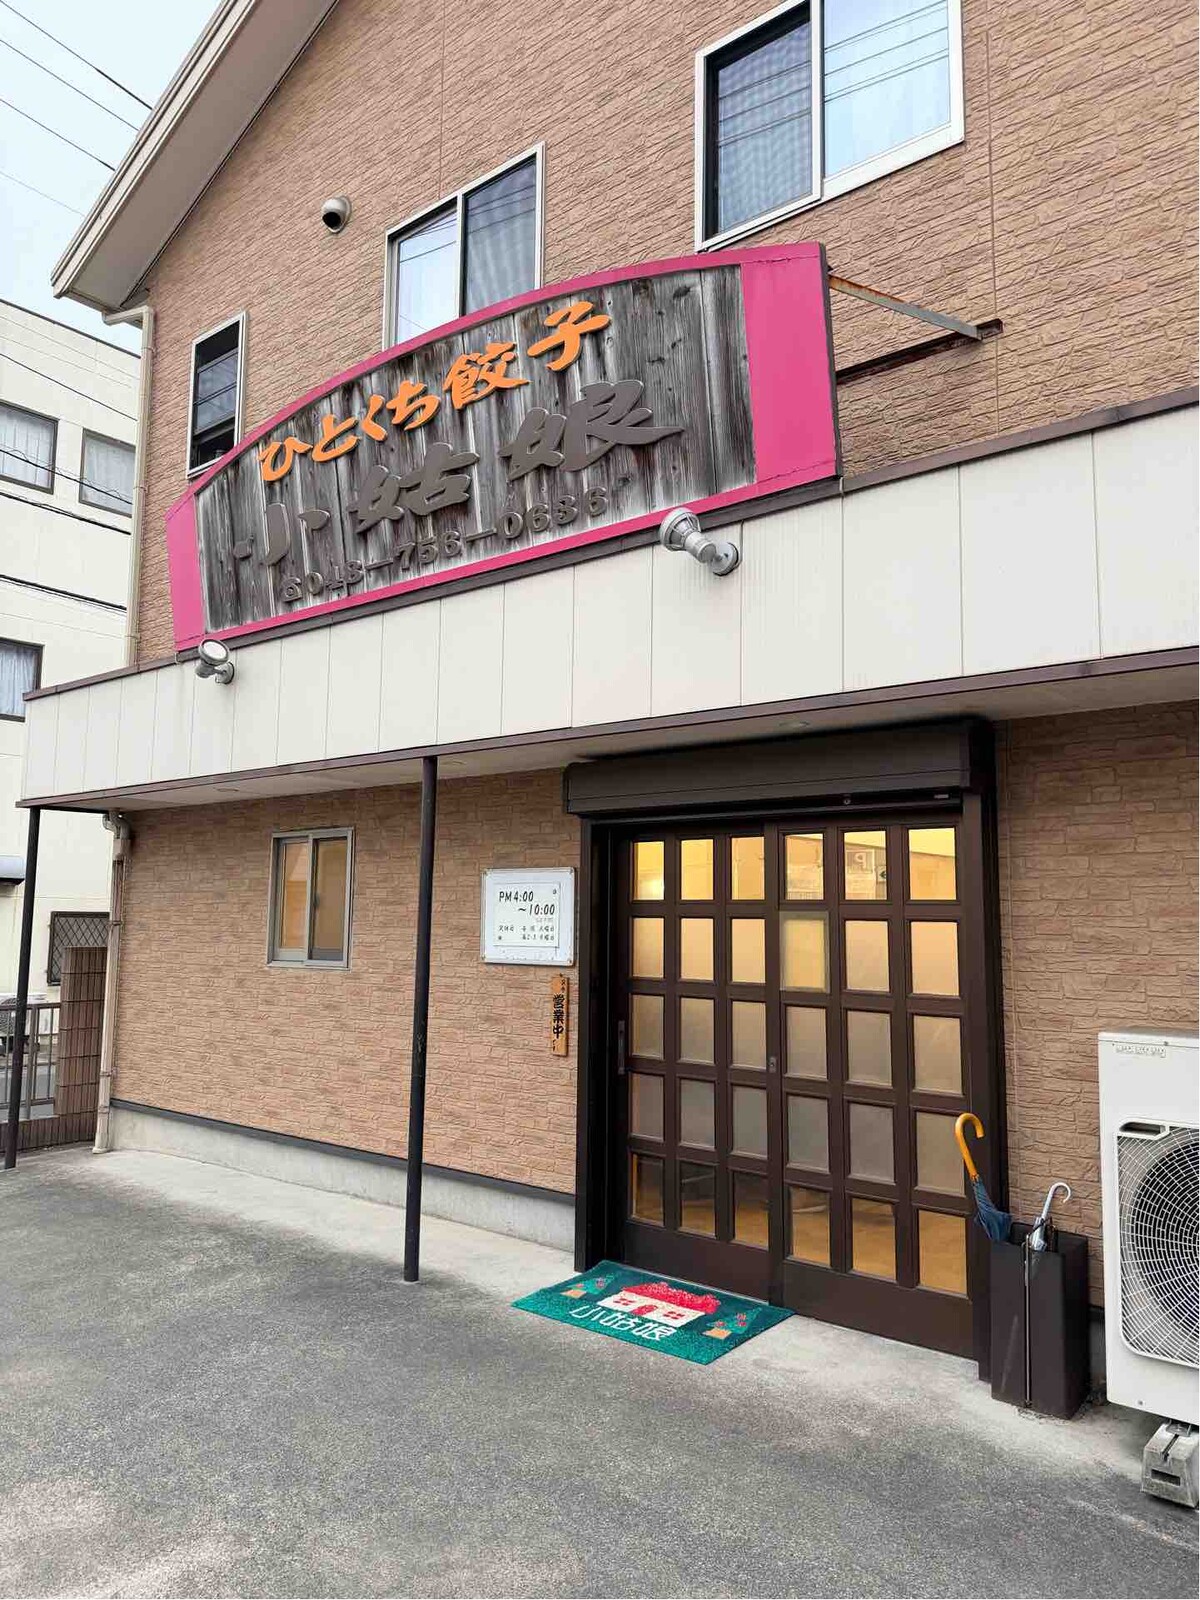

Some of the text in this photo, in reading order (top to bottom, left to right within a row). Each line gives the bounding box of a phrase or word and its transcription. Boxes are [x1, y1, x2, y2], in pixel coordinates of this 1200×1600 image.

[258, 301, 611, 482] ひとくち餃子
[233, 379, 686, 566] 小姑娘
[552, 993, 565, 1039] 営業中
[568, 1305, 677, 1341] 小姑娘
